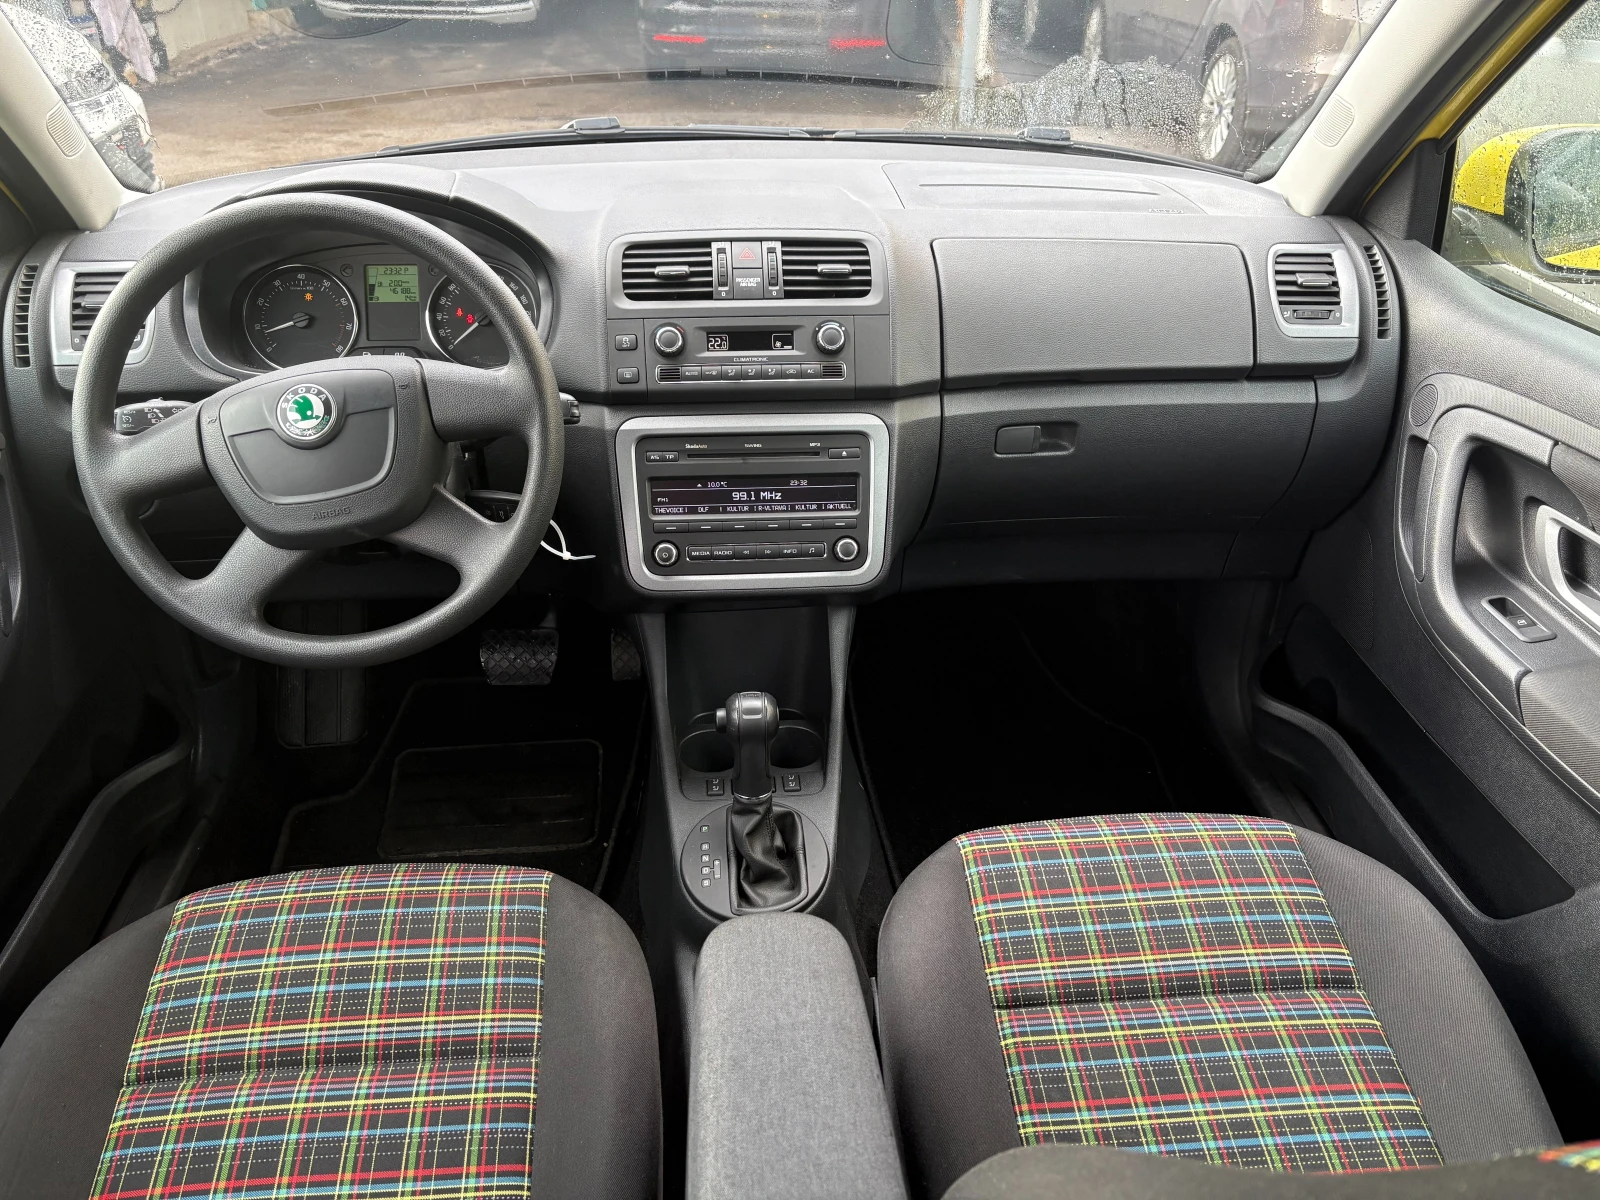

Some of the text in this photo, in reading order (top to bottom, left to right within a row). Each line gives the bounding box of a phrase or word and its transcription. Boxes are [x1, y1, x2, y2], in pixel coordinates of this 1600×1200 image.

[273, 279, 282, 288] 30
[322, 279, 331, 288] 50
[389, 279, 403, 287] 200
[447, 283, 456, 292] 80
[509, 282, 519, 291] 160
[256, 297, 265, 306] 20
[340, 297, 348, 306] 60
[439, 296, 447, 305] 60
[519, 294, 529, 305] 180
[436, 312, 443, 321] 40
[254, 323, 261, 331] 10
[345, 322, 353, 331] 70
[438, 329, 446, 337] 20
[335, 344, 344, 353] 80
[732, 491, 782, 501] 99.1 MHz
[795, 503, 818, 511] KULTUR
[311, 506, 351, 521] AIRBAG
